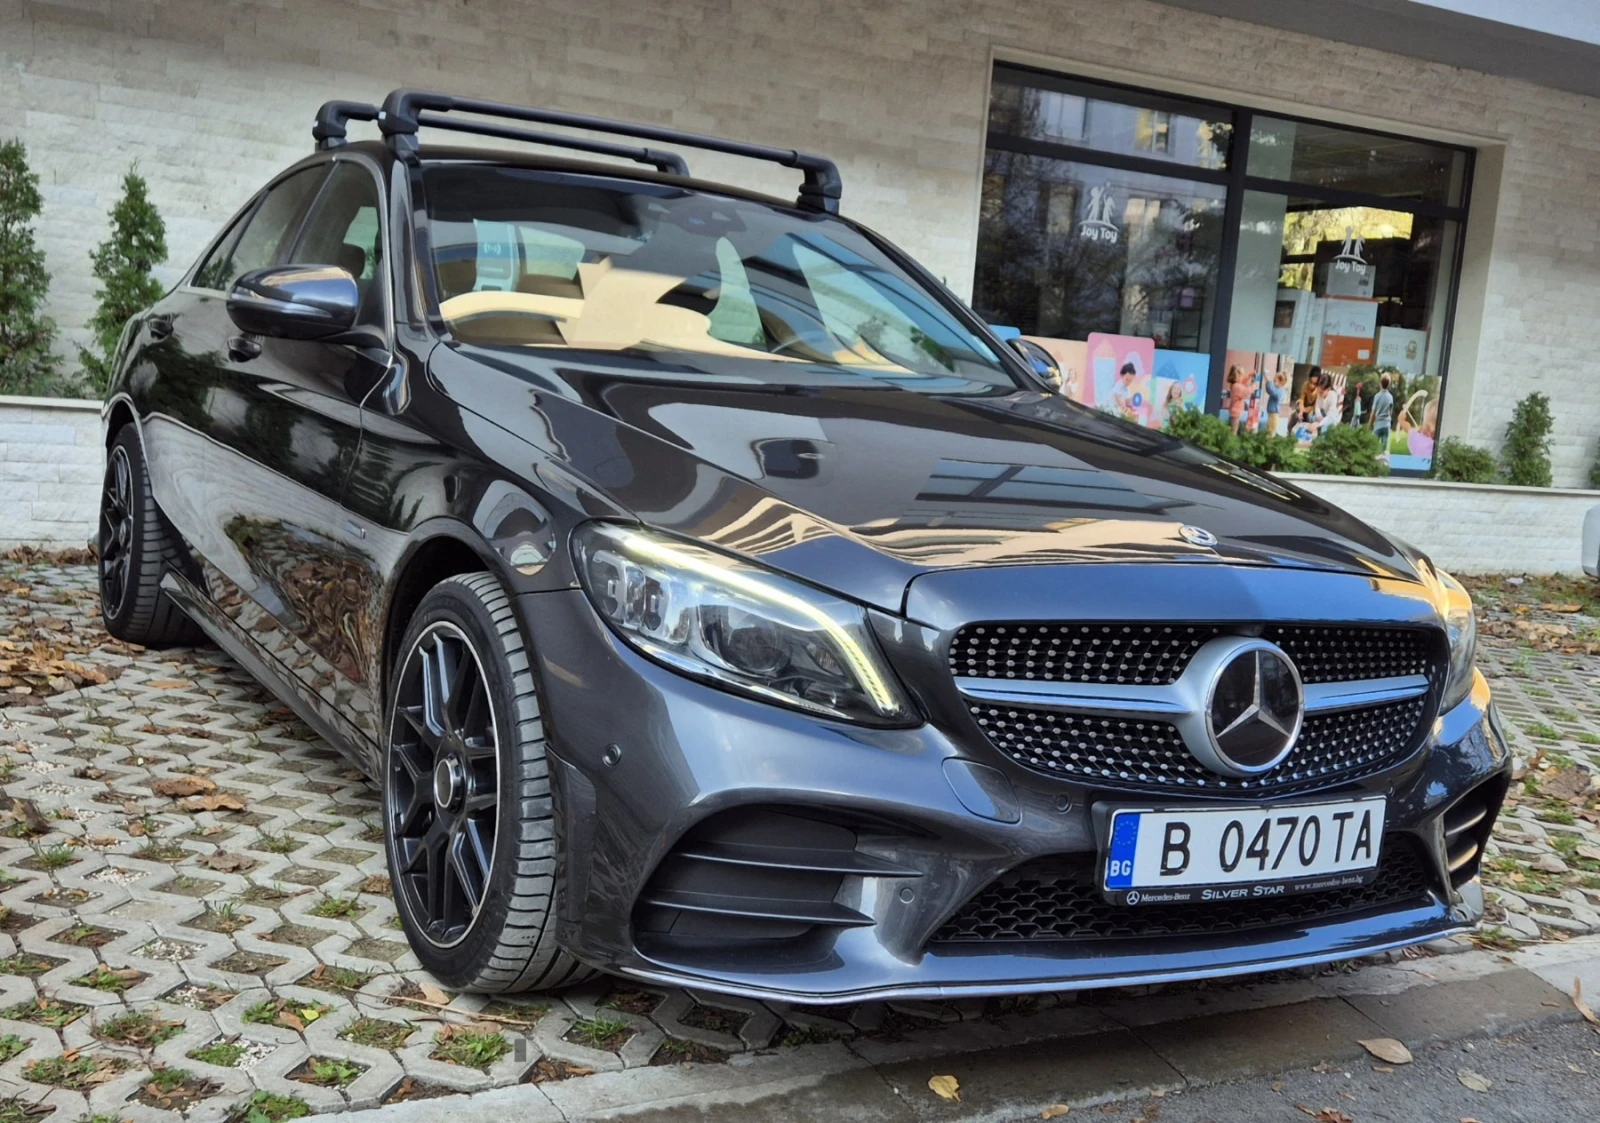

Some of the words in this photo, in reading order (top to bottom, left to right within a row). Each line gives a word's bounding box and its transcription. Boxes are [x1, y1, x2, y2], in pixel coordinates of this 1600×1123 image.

[1081, 225, 1099, 241] Joy
[1100, 227, 1118, 244] Toy
[1335, 260, 1350, 273] Joy
[1352, 261, 1367, 275] Toy
[1160, 821, 1191, 877] B
[1219, 814, 1321, 873] 0470
[1332, 809, 1371, 863] TA
[1110, 860, 1132, 877] BG
[1141, 893, 1191, 903] Mercedes-Benz
[1201, 888, 1248, 900] SILVER
[1253, 885, 1285, 897] STAR
